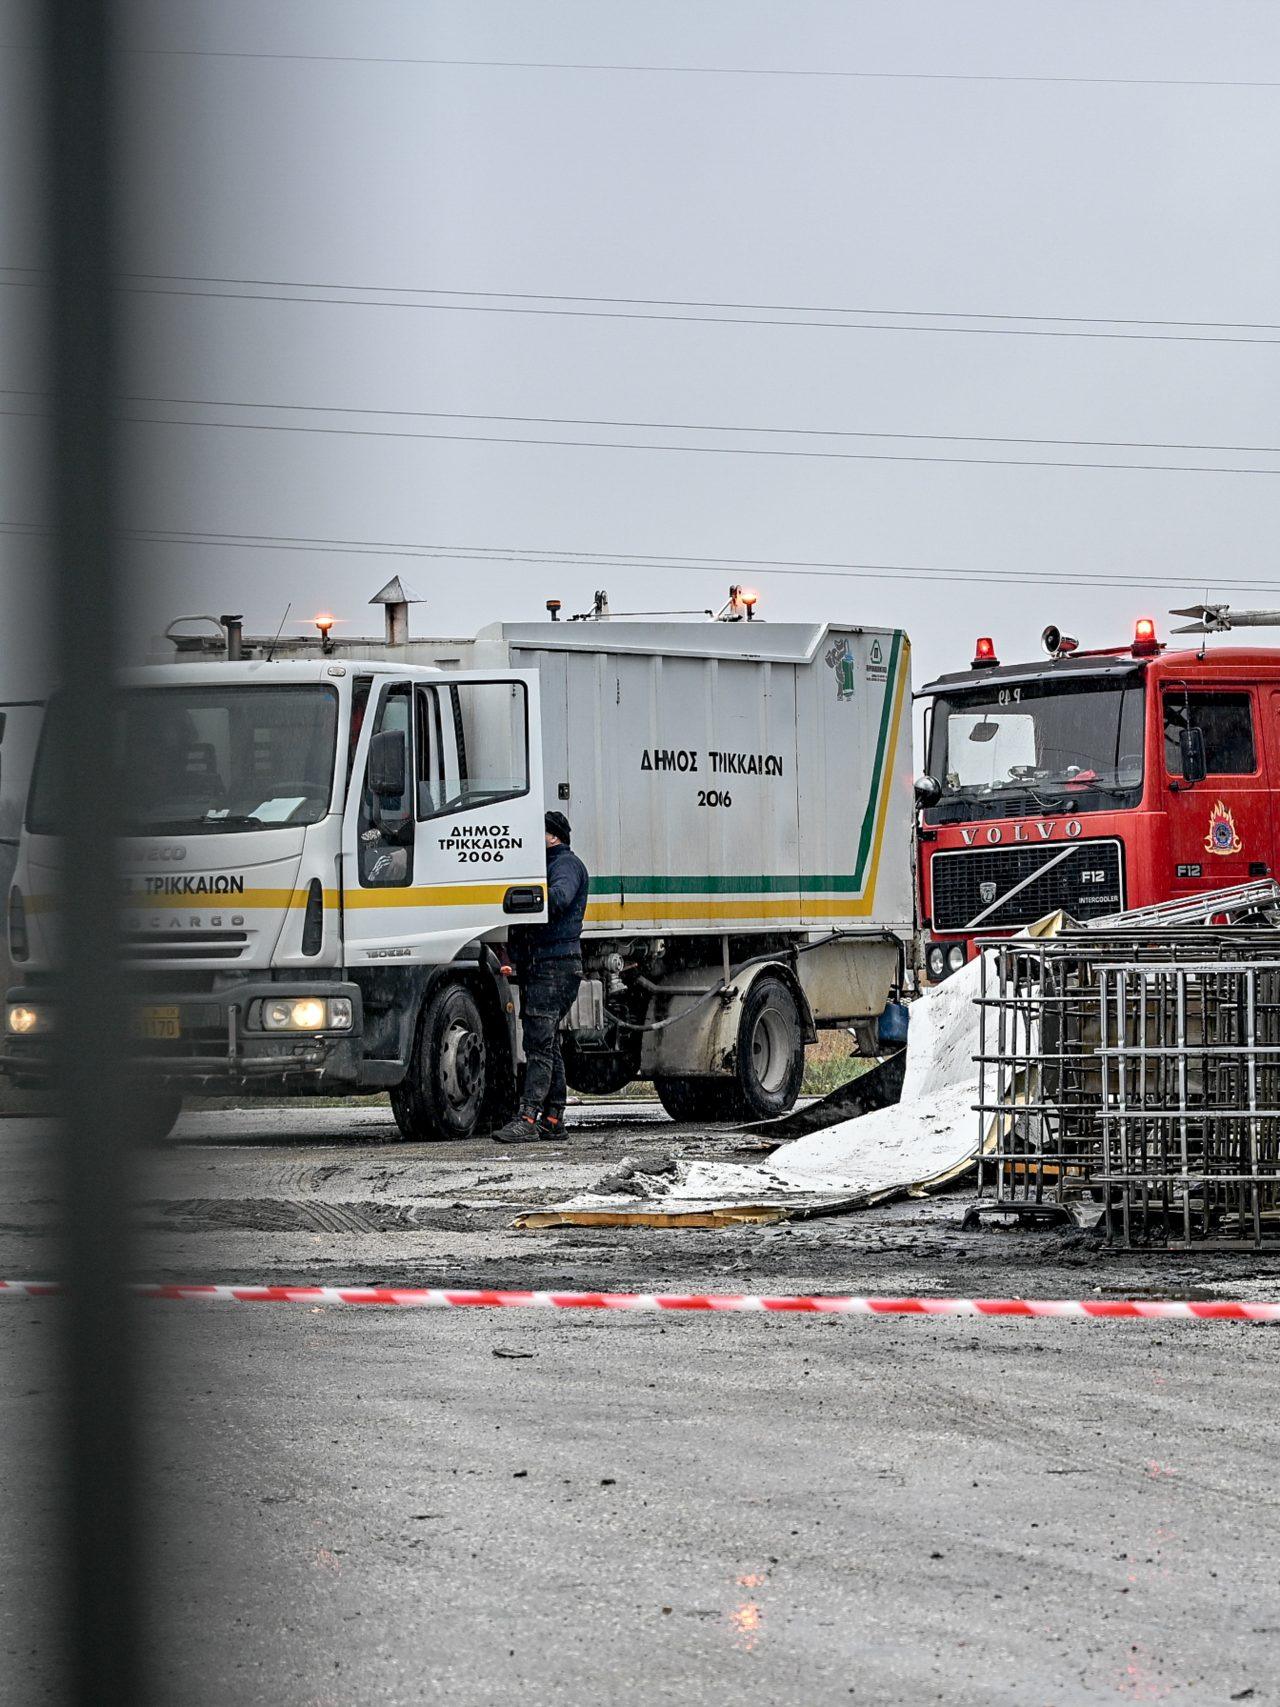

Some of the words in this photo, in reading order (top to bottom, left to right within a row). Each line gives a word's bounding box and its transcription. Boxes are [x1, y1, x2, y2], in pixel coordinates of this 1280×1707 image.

[640, 749, 698, 772] ΔΗΜΟΣ
[450, 825, 510, 837] ΔΗΜΟΣ
[960, 820, 1083, 846] VOLVO
[438, 838, 523, 850] ΤΡΙΚΚΑΙΩΝ
[457, 851, 504, 863] 2006
[1081, 870, 1106, 883] F12
[1177, 865, 1201, 877] F12
[144, 875, 244, 896] ΤΡΙΚΚΑΙΩΝ
[1078, 895, 1119, 904] INTERCOOLER
